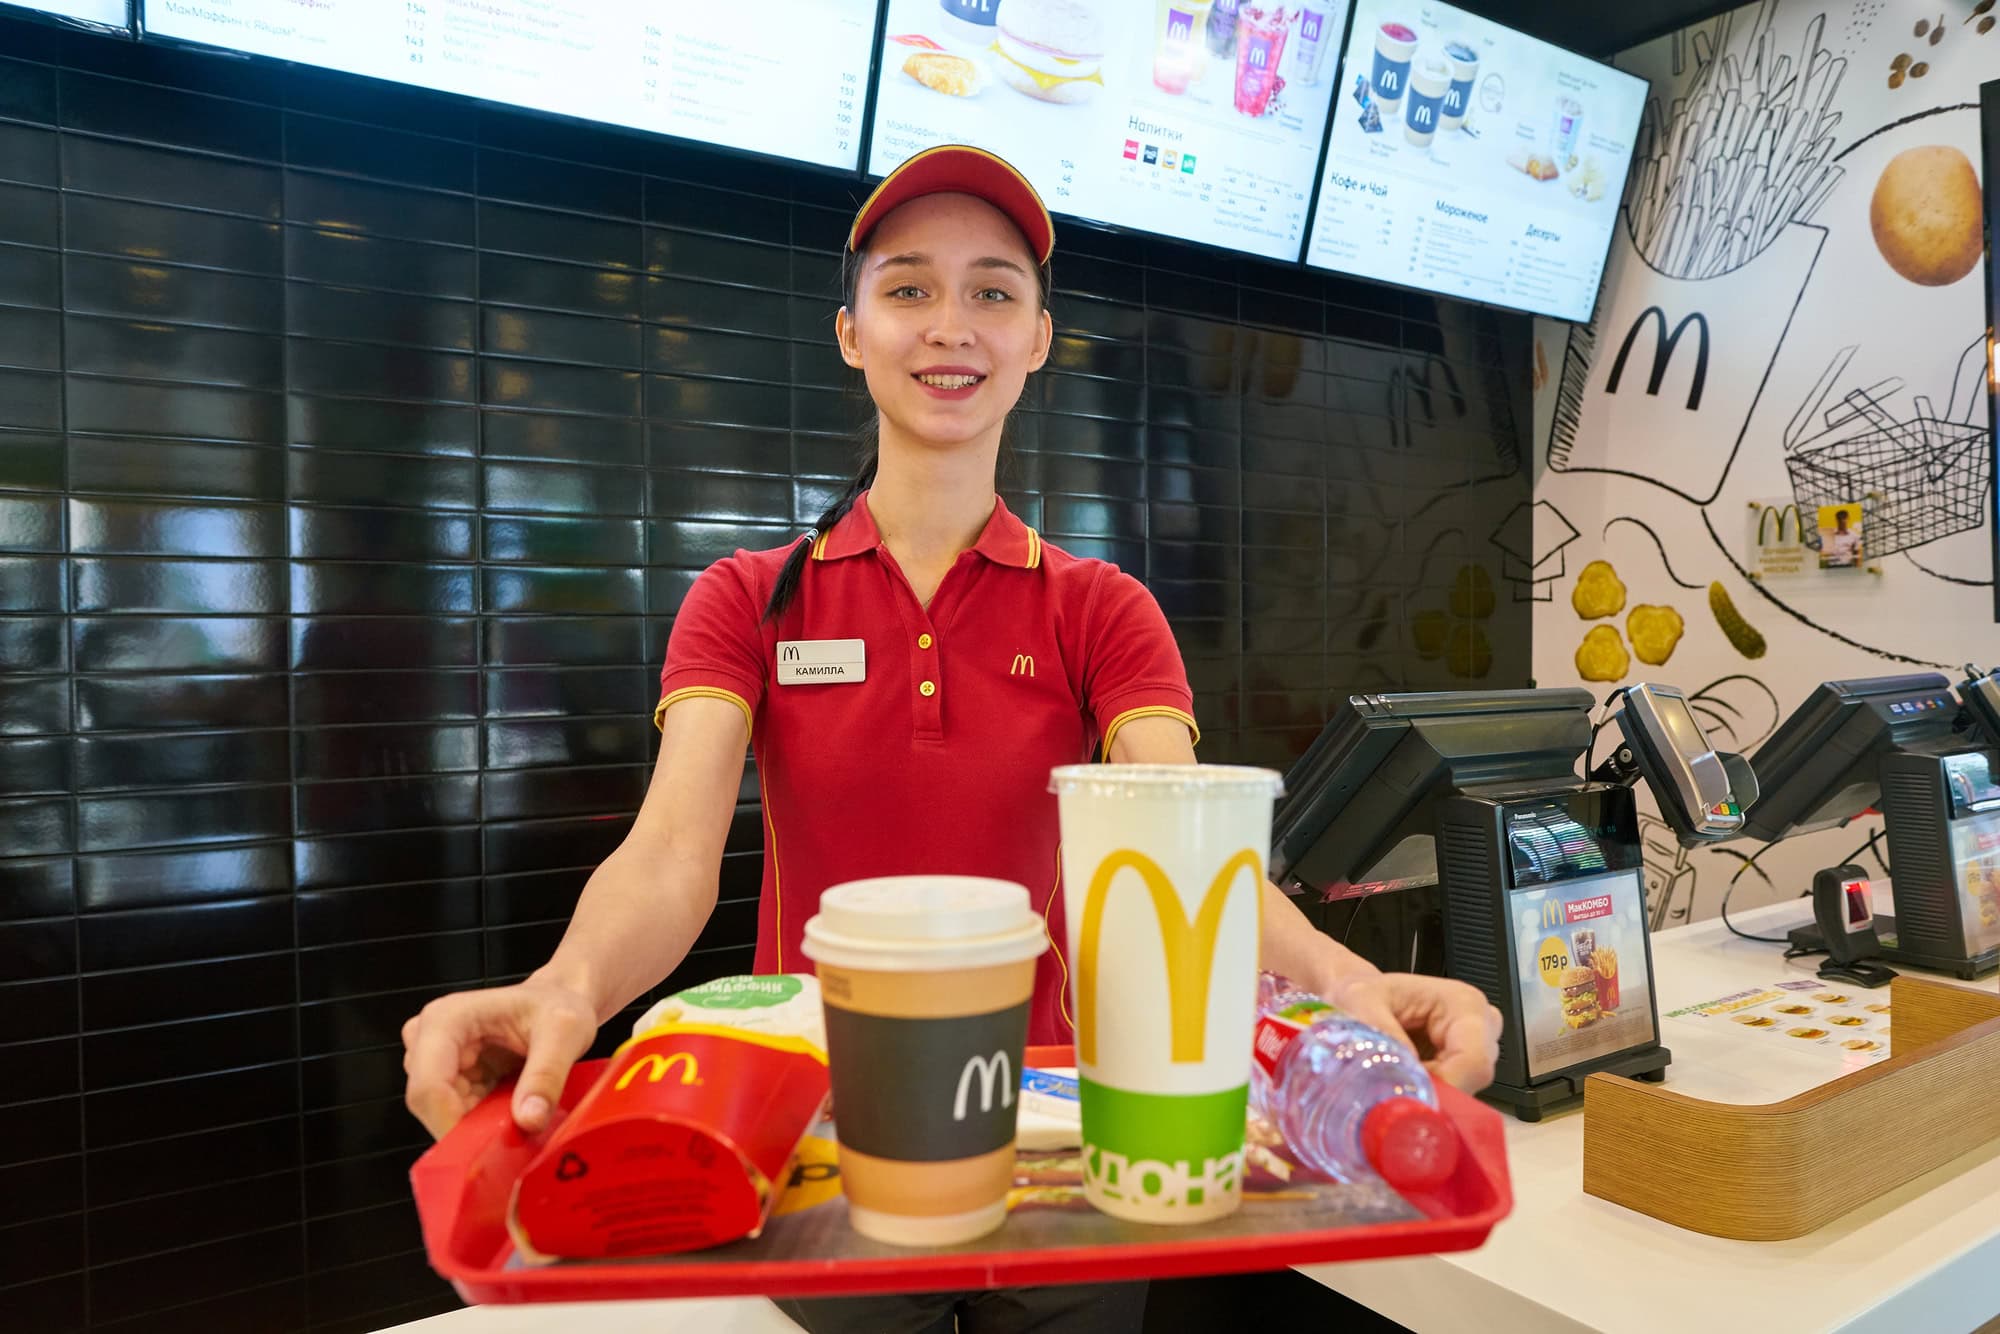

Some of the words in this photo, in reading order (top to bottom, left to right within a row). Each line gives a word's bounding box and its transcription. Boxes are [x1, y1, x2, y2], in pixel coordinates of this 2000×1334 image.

[405, 34, 424, 48] 143
[409, 52, 424, 64] 83
[1128, 115, 1184, 142] Напитки
[1331, 172, 1358, 191] Кофе
[1369, 180, 1388, 198] Чай
[1435, 200, 1488, 224] Мороженое
[1525, 223, 1562, 243] Десерты
[795, 666, 845, 676] КАМИЛЛА
[1567, 897, 1609, 914] МакКОМБО
[1541, 954, 1560, 971] 179
